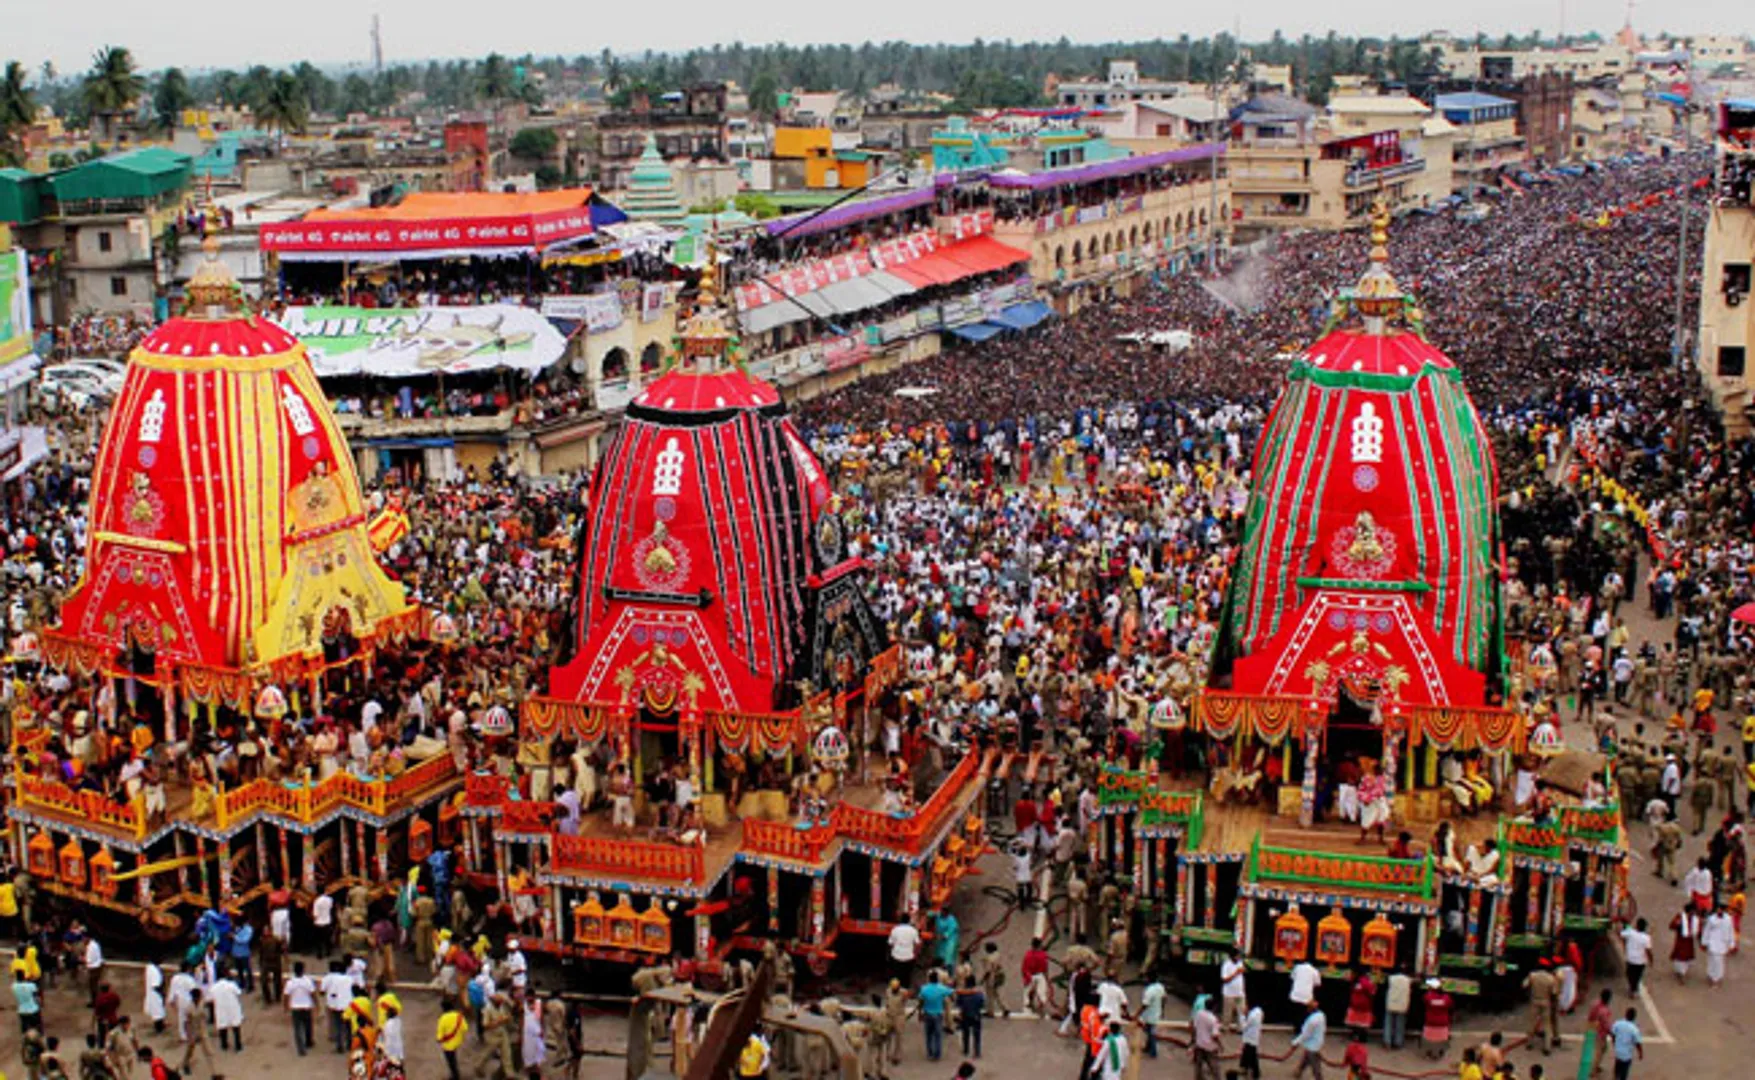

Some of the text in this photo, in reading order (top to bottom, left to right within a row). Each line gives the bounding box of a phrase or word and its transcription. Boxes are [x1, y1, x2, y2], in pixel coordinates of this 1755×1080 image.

[410, 227, 460, 241] airtel 4G
[478, 224, 508, 238] airtel
[512, 223, 529, 236] 4G
[290, 311, 432, 337] MILKY
